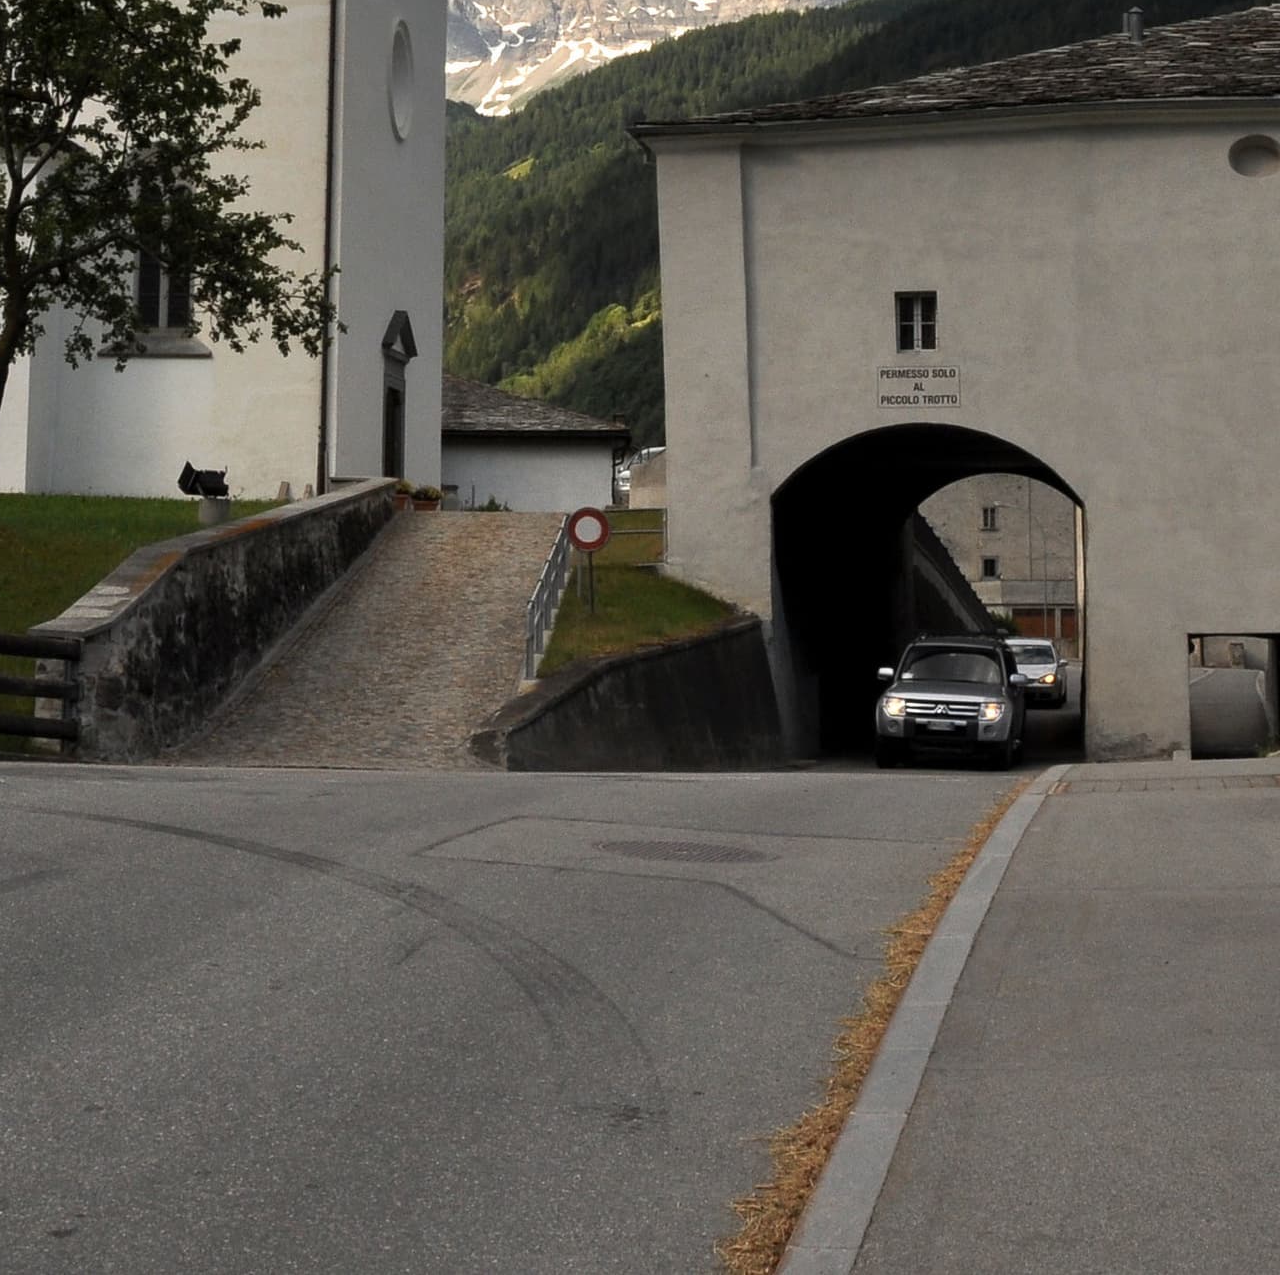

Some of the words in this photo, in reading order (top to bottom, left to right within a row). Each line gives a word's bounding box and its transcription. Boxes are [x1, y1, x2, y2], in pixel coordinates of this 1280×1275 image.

[880, 369, 929, 379] PERMESSO
[932, 368, 956, 379] SOLO
[913, 382, 925, 392] AL
[881, 395, 920, 405] PICCOLO
[923, 394, 958, 405] TROTTO
